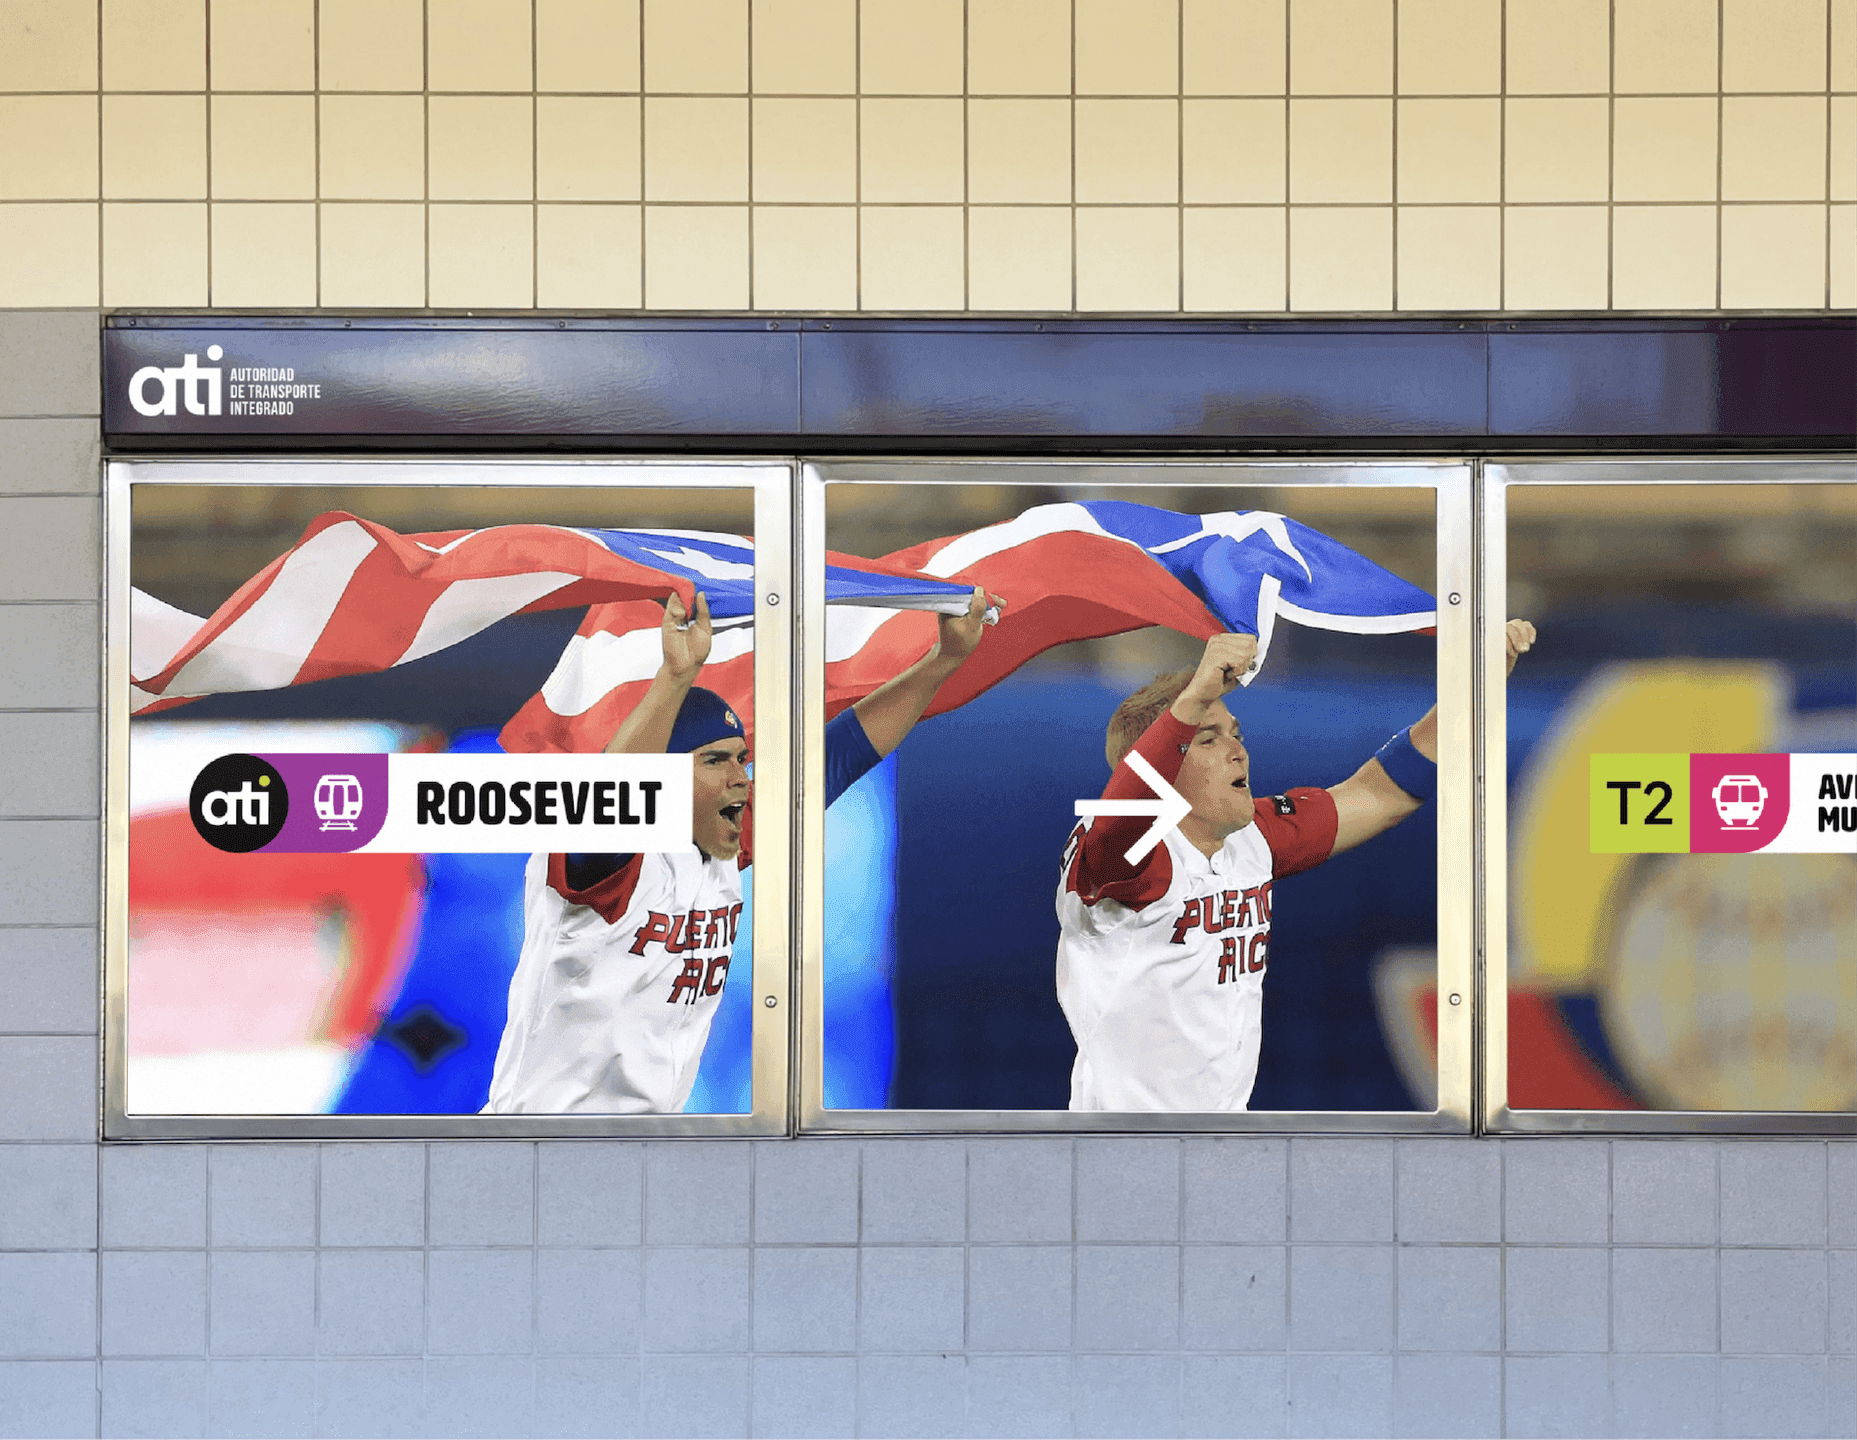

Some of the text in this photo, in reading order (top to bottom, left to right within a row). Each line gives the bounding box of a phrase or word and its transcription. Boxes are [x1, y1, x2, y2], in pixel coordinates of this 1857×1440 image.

[128, 344, 224, 417] ati
[229, 367, 295, 382] AUTORIDAD
[230, 384, 321, 399] DE TRANSPORTE
[229, 401, 294, 416] INTEGRADO
[201, 775, 271, 826] ati
[417, 781, 663, 826] ROOSEVELT
[1606, 780, 1673, 825] T2
[1818, 774, 1857, 800] AV
